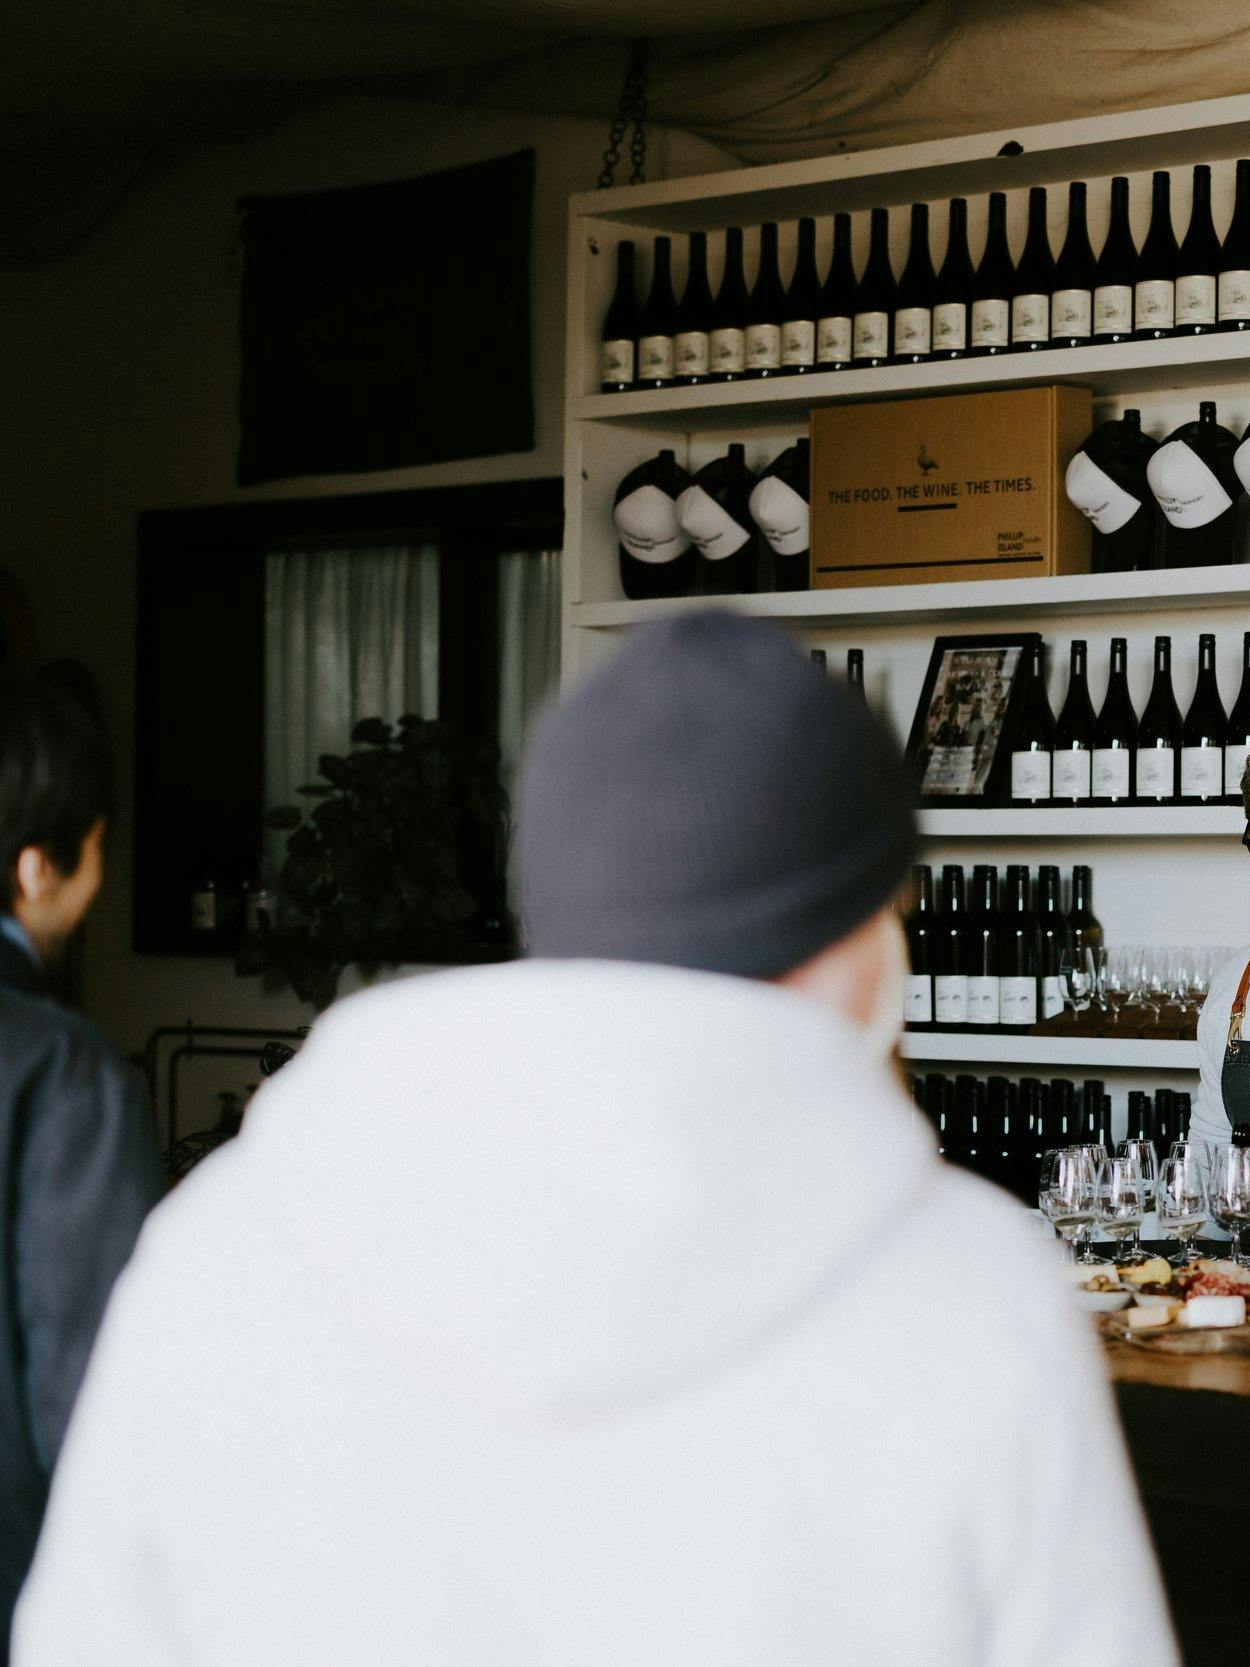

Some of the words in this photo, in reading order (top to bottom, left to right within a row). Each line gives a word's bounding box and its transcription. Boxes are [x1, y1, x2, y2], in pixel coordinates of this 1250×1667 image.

[828, 490, 852, 505] THE
[854, 488, 893, 503] FOOD.
[896, 486, 920, 499] THE
[923, 483, 962, 498] WINE.
[967, 480, 990, 494] THE
[995, 477, 1035, 492] TIMES.
